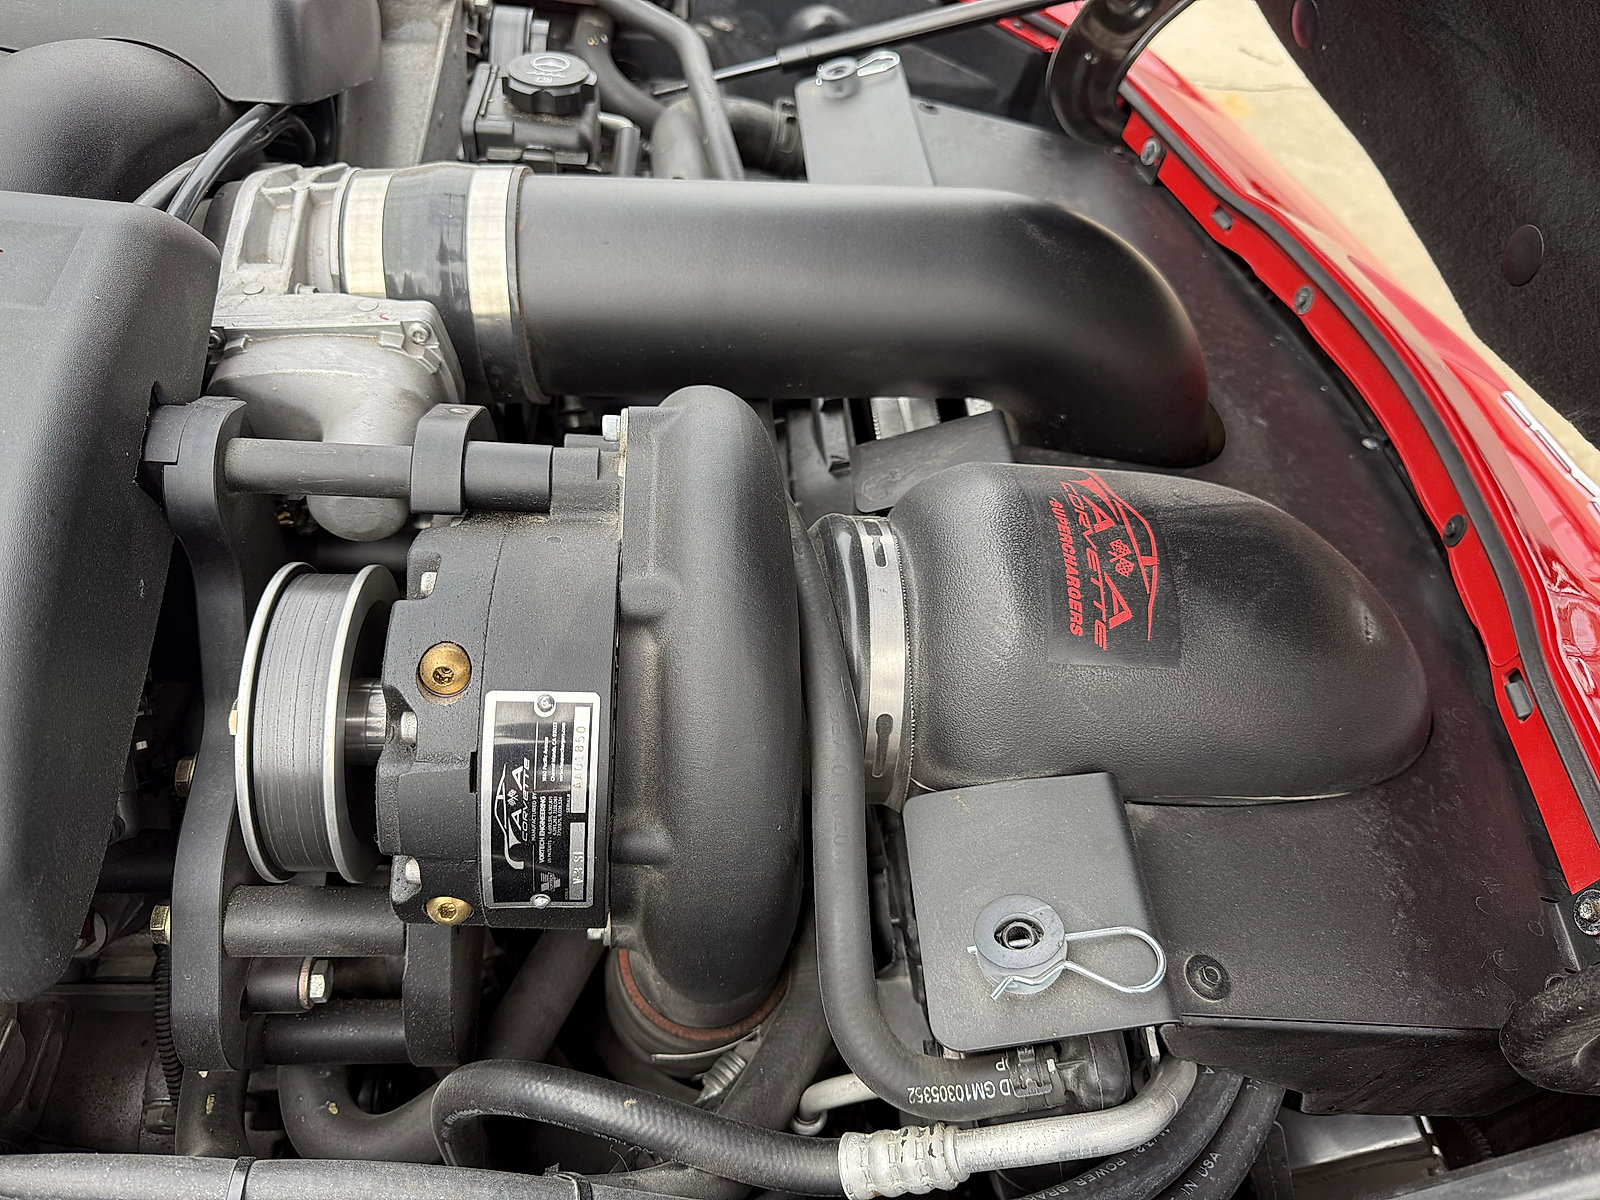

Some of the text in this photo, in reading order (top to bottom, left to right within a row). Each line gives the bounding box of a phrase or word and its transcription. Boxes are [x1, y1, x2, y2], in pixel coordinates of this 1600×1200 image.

[1049, 500, 1084, 637] SUPERCHARGERS
[1060, 481, 1107, 650] CORVETTE
[522, 757, 530, 841] CORVETTE
[907, 1081, 996, 1104] GM10305352
[1073, 1157, 1127, 1187] POWER
[1181, 1152, 1222, 1196] IN USA
